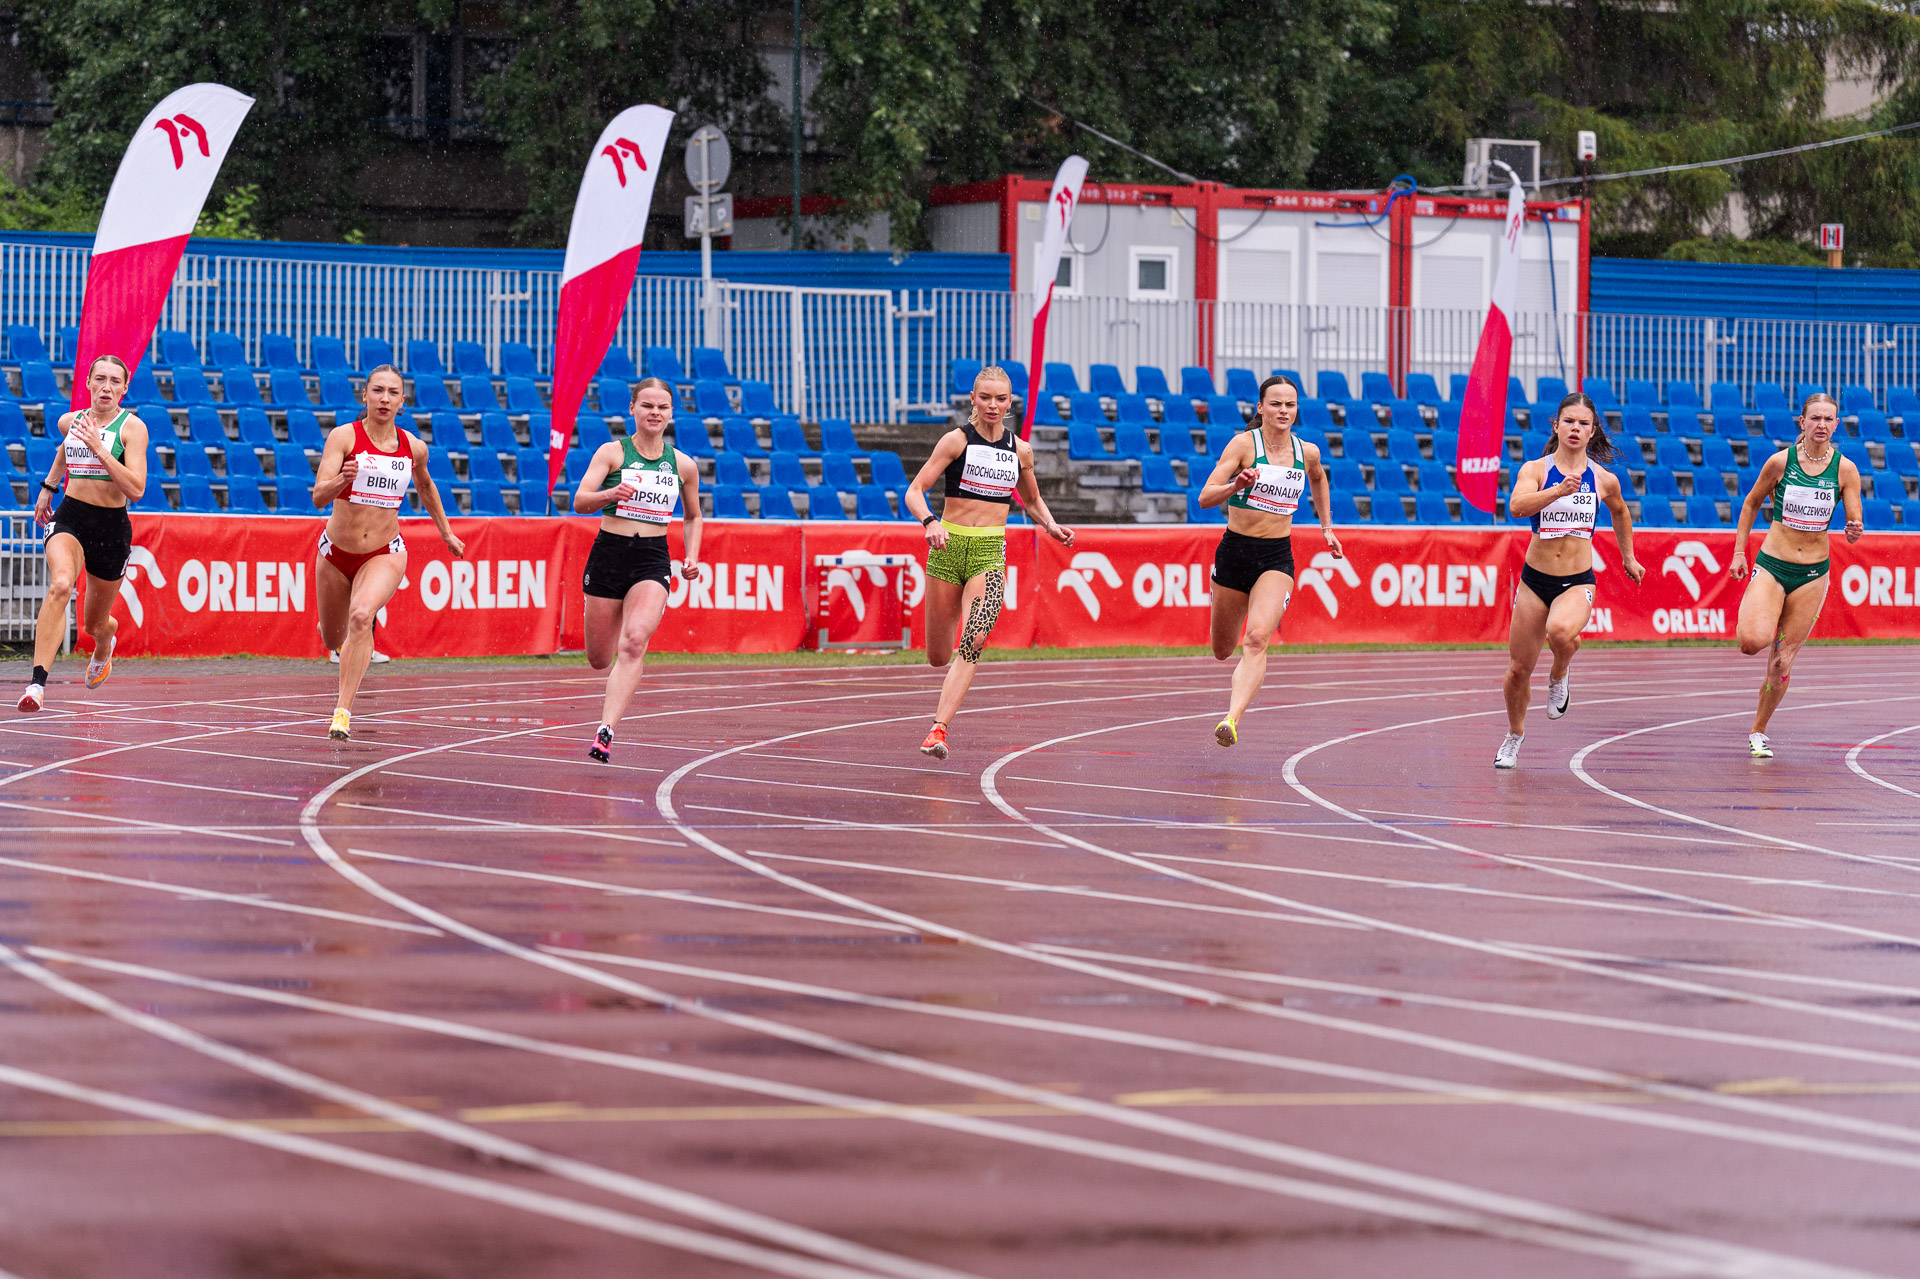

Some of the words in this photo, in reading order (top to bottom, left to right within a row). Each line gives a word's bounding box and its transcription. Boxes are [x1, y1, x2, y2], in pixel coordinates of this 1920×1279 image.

[995, 452, 1014, 463] 104
[391, 460, 405, 471] 80
[965, 463, 1016, 482] TROCHOLEPSZA
[366, 475, 399, 490] BIBIK
[655, 475, 673, 487] 148
[1285, 470, 1303, 482] 349
[1253, 482, 1302, 499] FORNALIK
[1814, 491, 1832, 501] 108
[1572, 495, 1592, 505] 382
[626, 512, 652, 521] KRAKÓW
[1542, 511, 1594, 523] KACZMAREK
[1784, 502, 1831, 517] ADAMCZEWSKA
[178, 559, 305, 613] ORLEN
[420, 559, 547, 612] ORLEN
[666, 559, 784, 612] ORLEN
[1132, 562, 1210, 608] ORL
[1370, 562, 1498, 607] ORLEN
[1841, 564, 1920, 607] ORL
[1652, 607, 1726, 634] ORLEN
